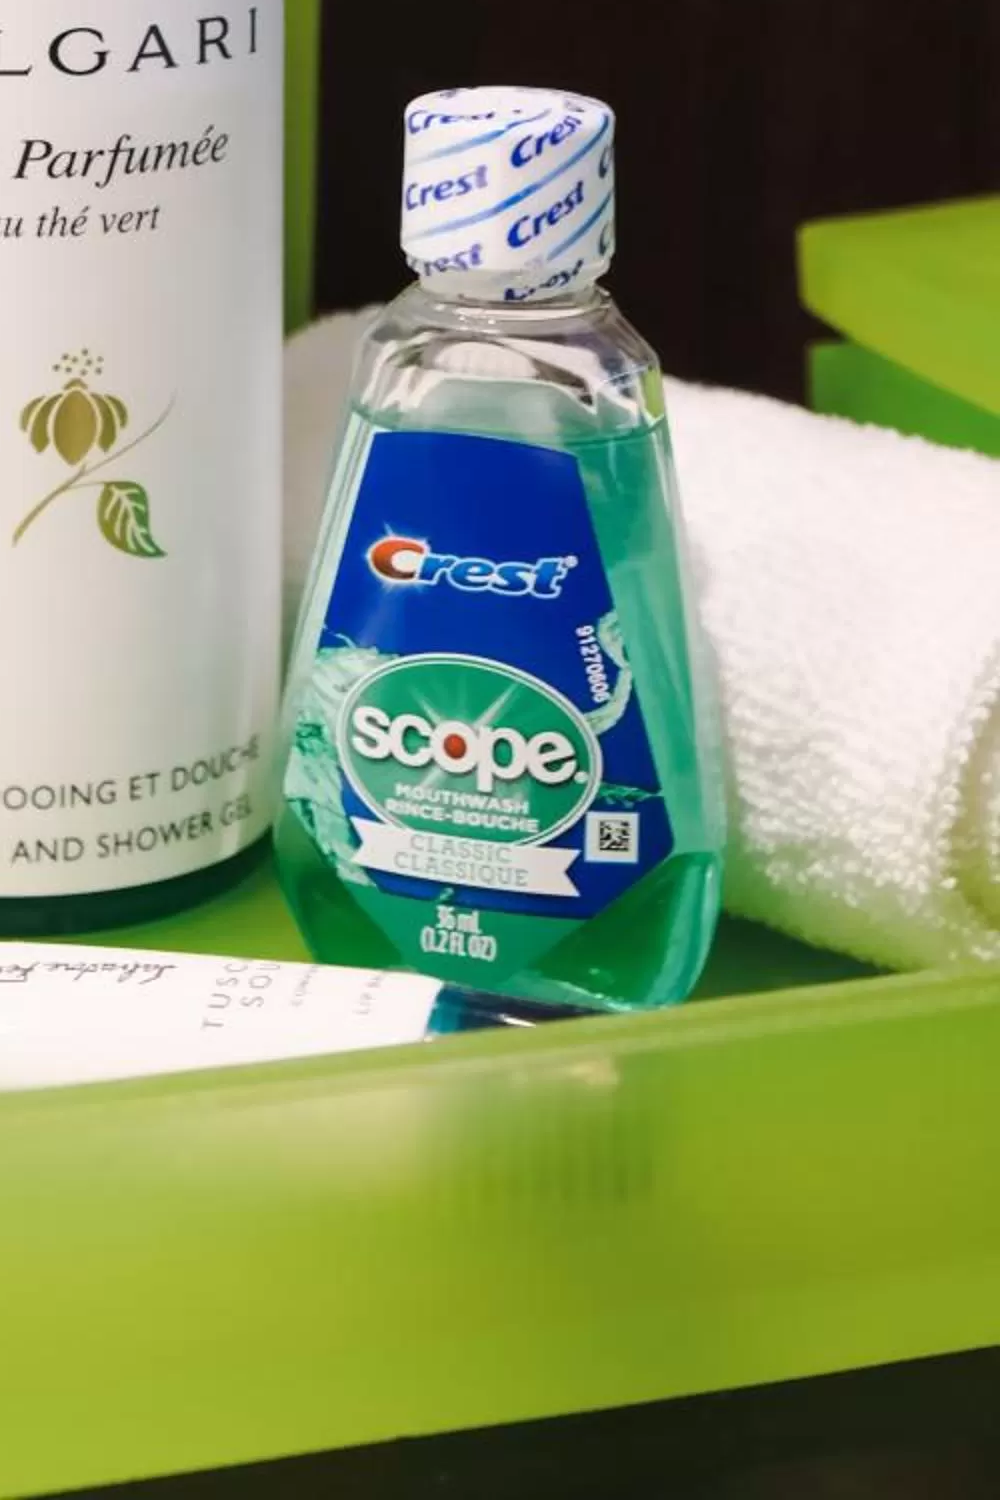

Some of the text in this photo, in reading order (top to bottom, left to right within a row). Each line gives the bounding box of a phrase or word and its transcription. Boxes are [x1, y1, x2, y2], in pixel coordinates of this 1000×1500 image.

[10, 124, 230, 189] Parfumée
[404, 164, 489, 211] Crest
[36, 204, 89, 238] thé
[100, 203, 162, 235] vert
[506, 180, 584, 249] Crest
[129, 772, 162, 801] ET
[394, 783, 530, 815] MOUTHWASH
[384, 797, 540, 834] RINCE-BOUCHE
[10, 837, 86, 865] AND
[96, 811, 214, 860] SHOWER
[409, 832, 513, 865] CLASSIC
[392, 850, 530, 888] CLASSIQUE
